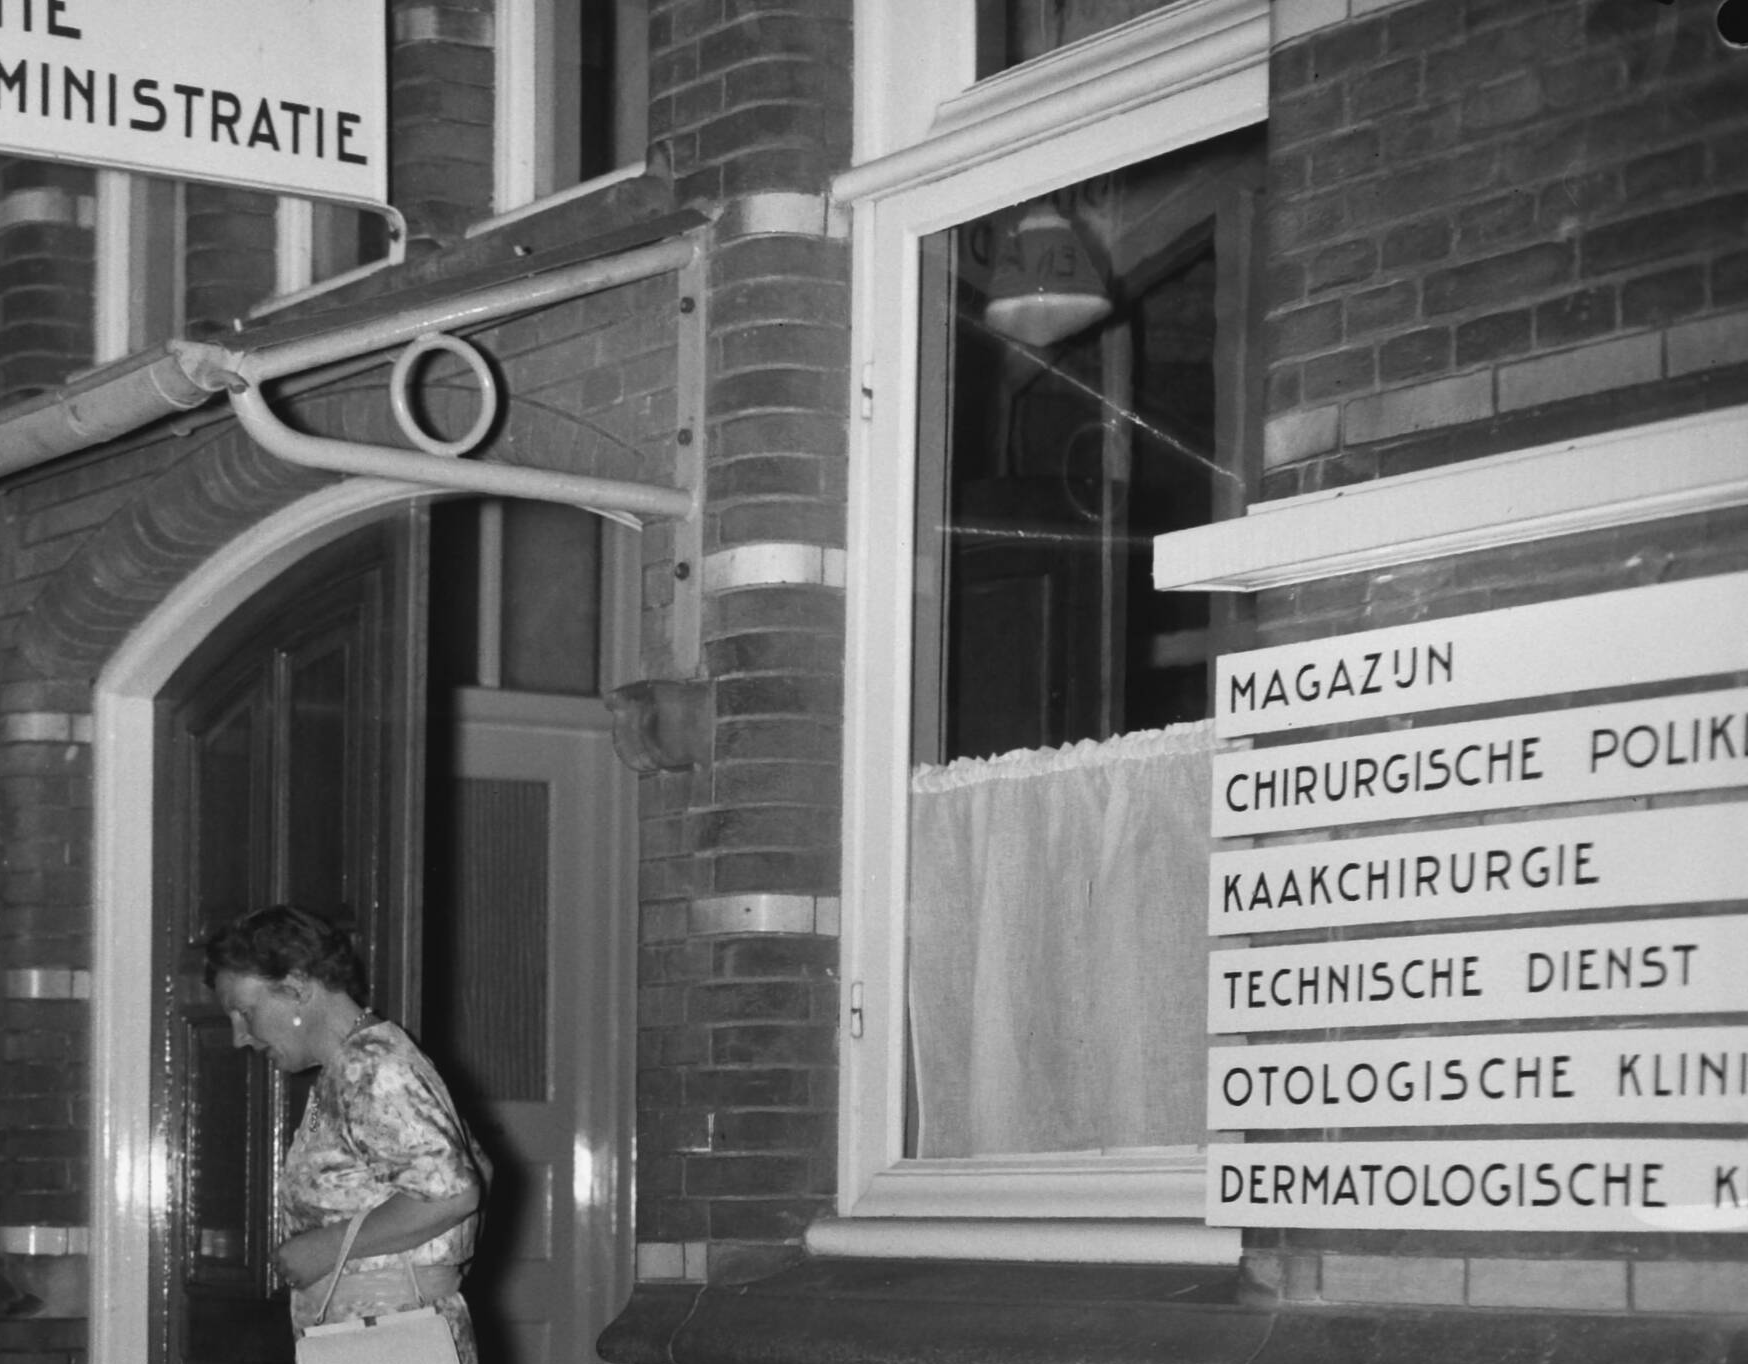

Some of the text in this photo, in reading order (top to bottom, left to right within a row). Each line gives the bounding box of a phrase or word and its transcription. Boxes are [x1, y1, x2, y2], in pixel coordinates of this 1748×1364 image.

[1225, 736, 1544, 813] CHIRURGISCHE
[1223, 842, 1600, 913] KAAKCHIRURGIE
[1223, 944, 1699, 1009] TECHNISCHE DIENST
[1222, 1055, 1575, 1107] OTOLOGISCHE
[1220, 1162, 1667, 1208] DERMATOLOGISCHE
